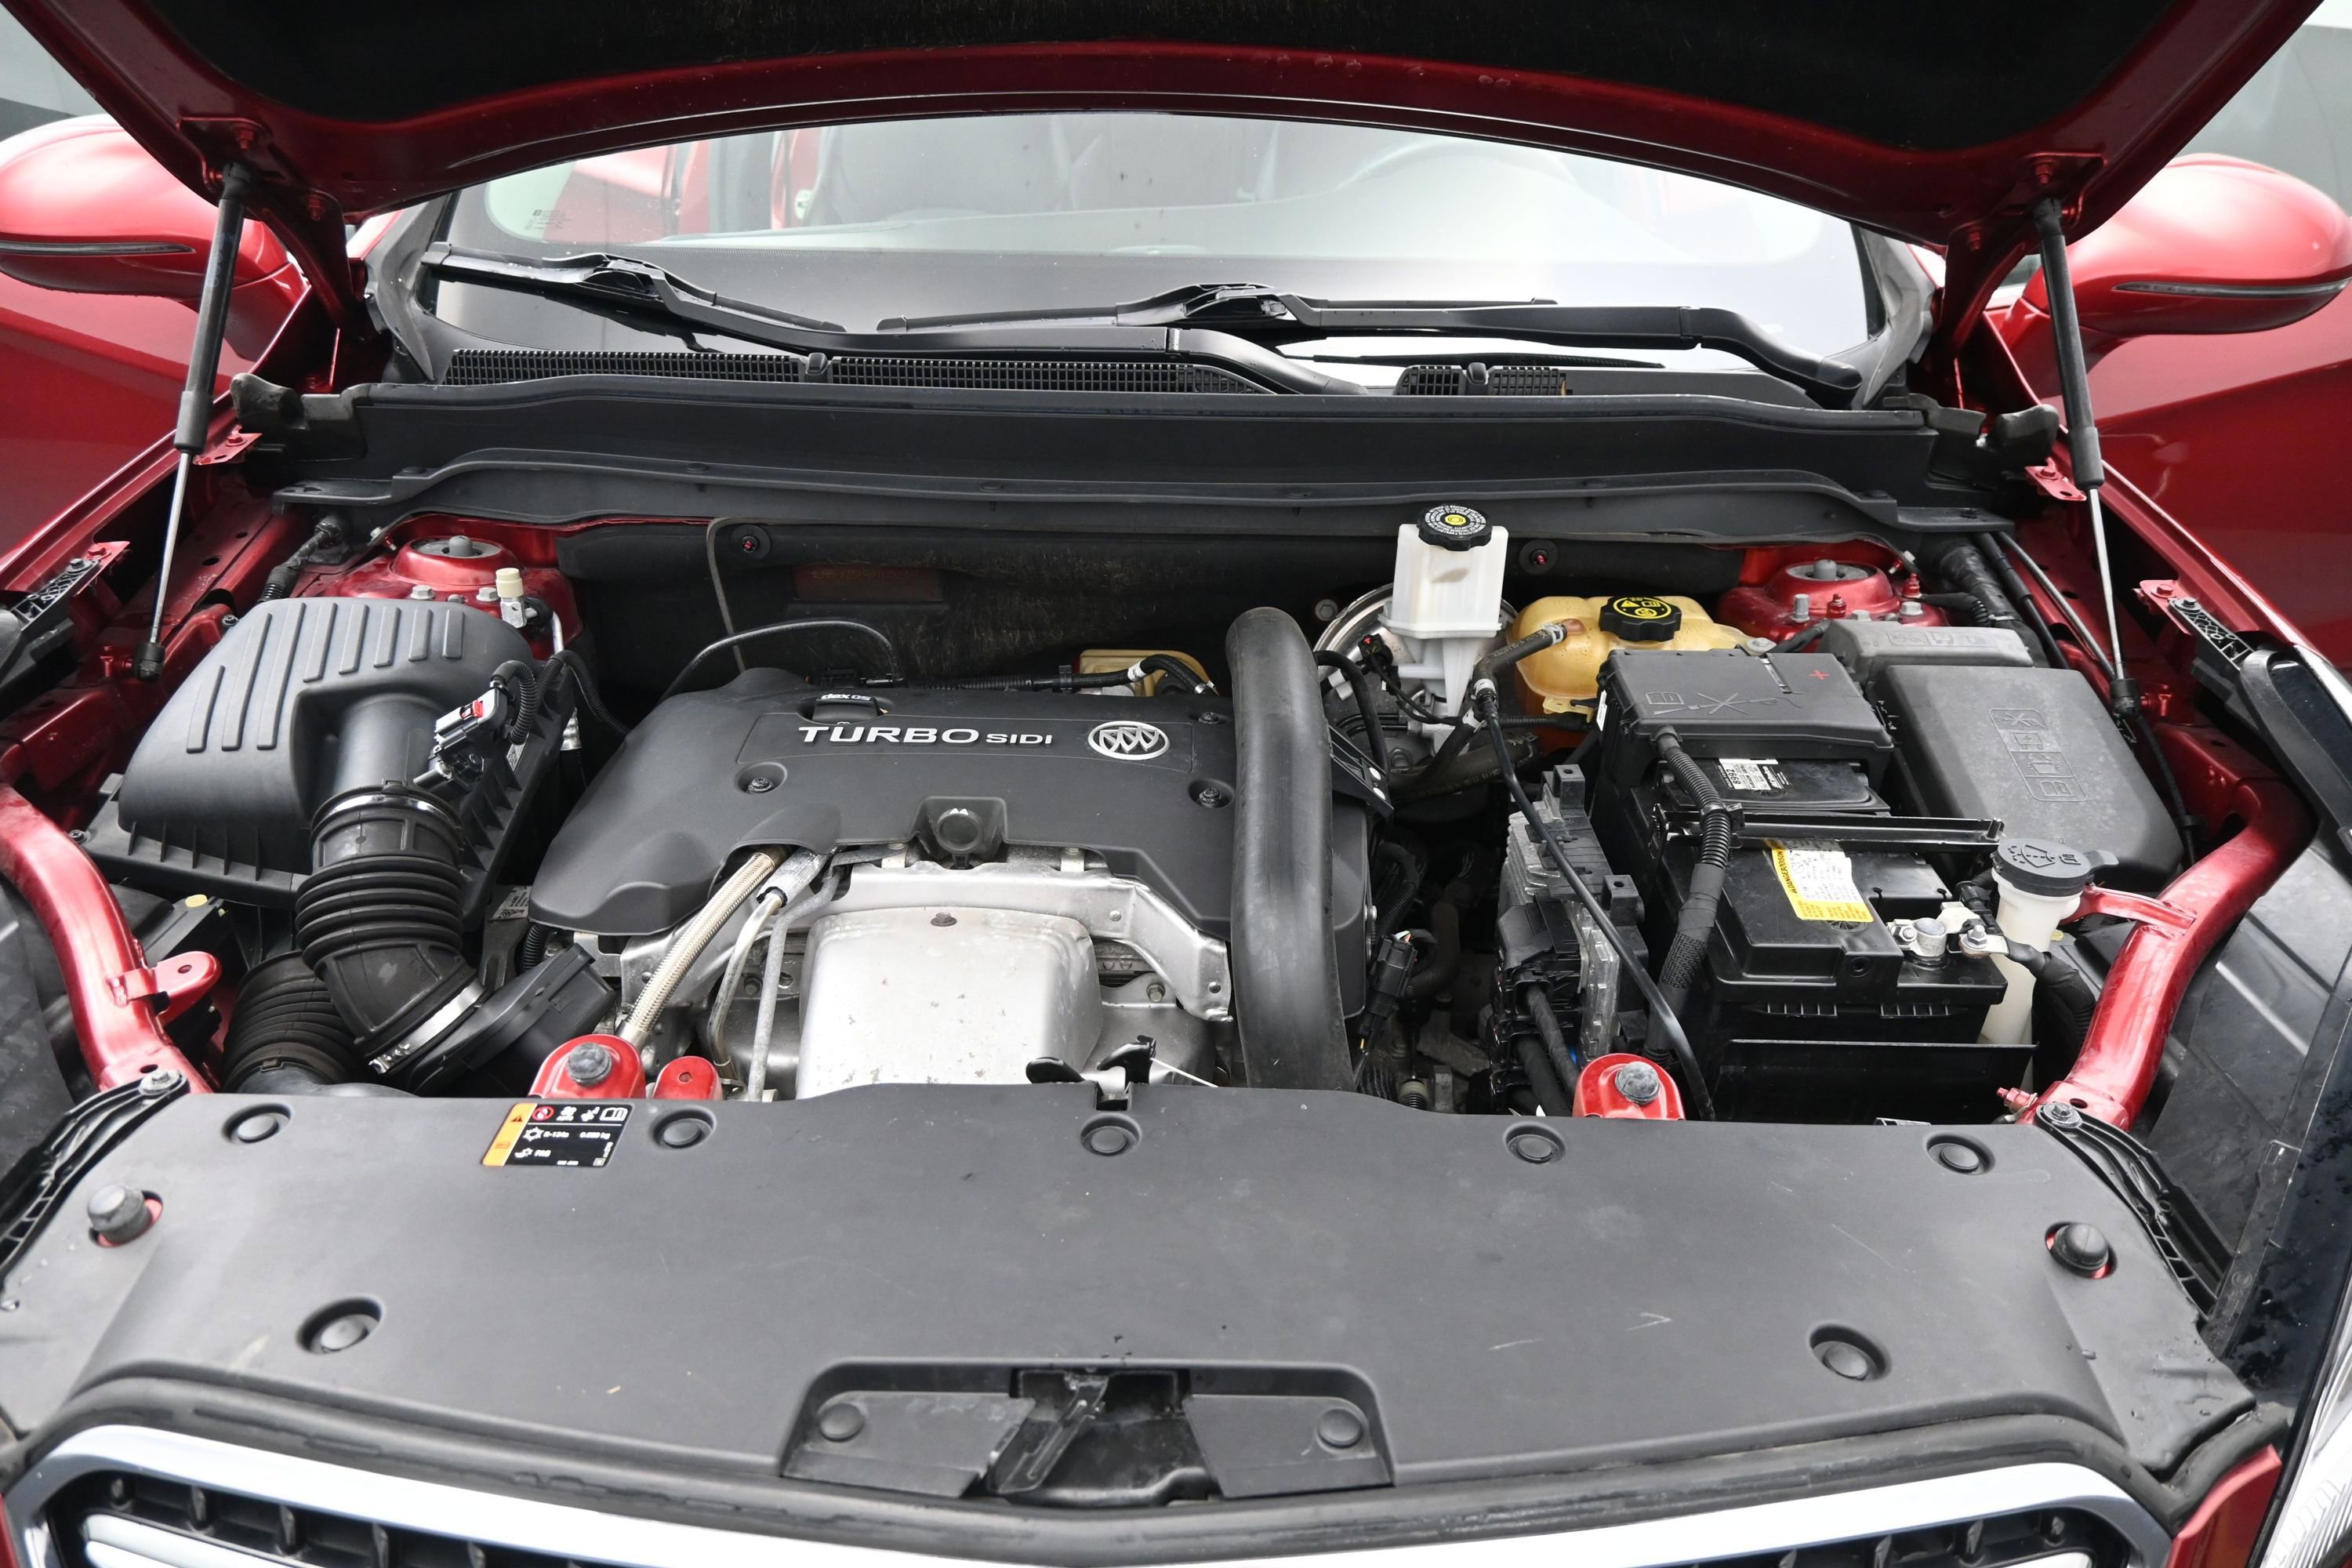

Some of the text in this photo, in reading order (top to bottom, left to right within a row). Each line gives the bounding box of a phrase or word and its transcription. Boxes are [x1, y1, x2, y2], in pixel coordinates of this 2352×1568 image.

[798, 727, 1053, 745] TURBO SIDI
[1726, 768, 1741, 785] 8992
